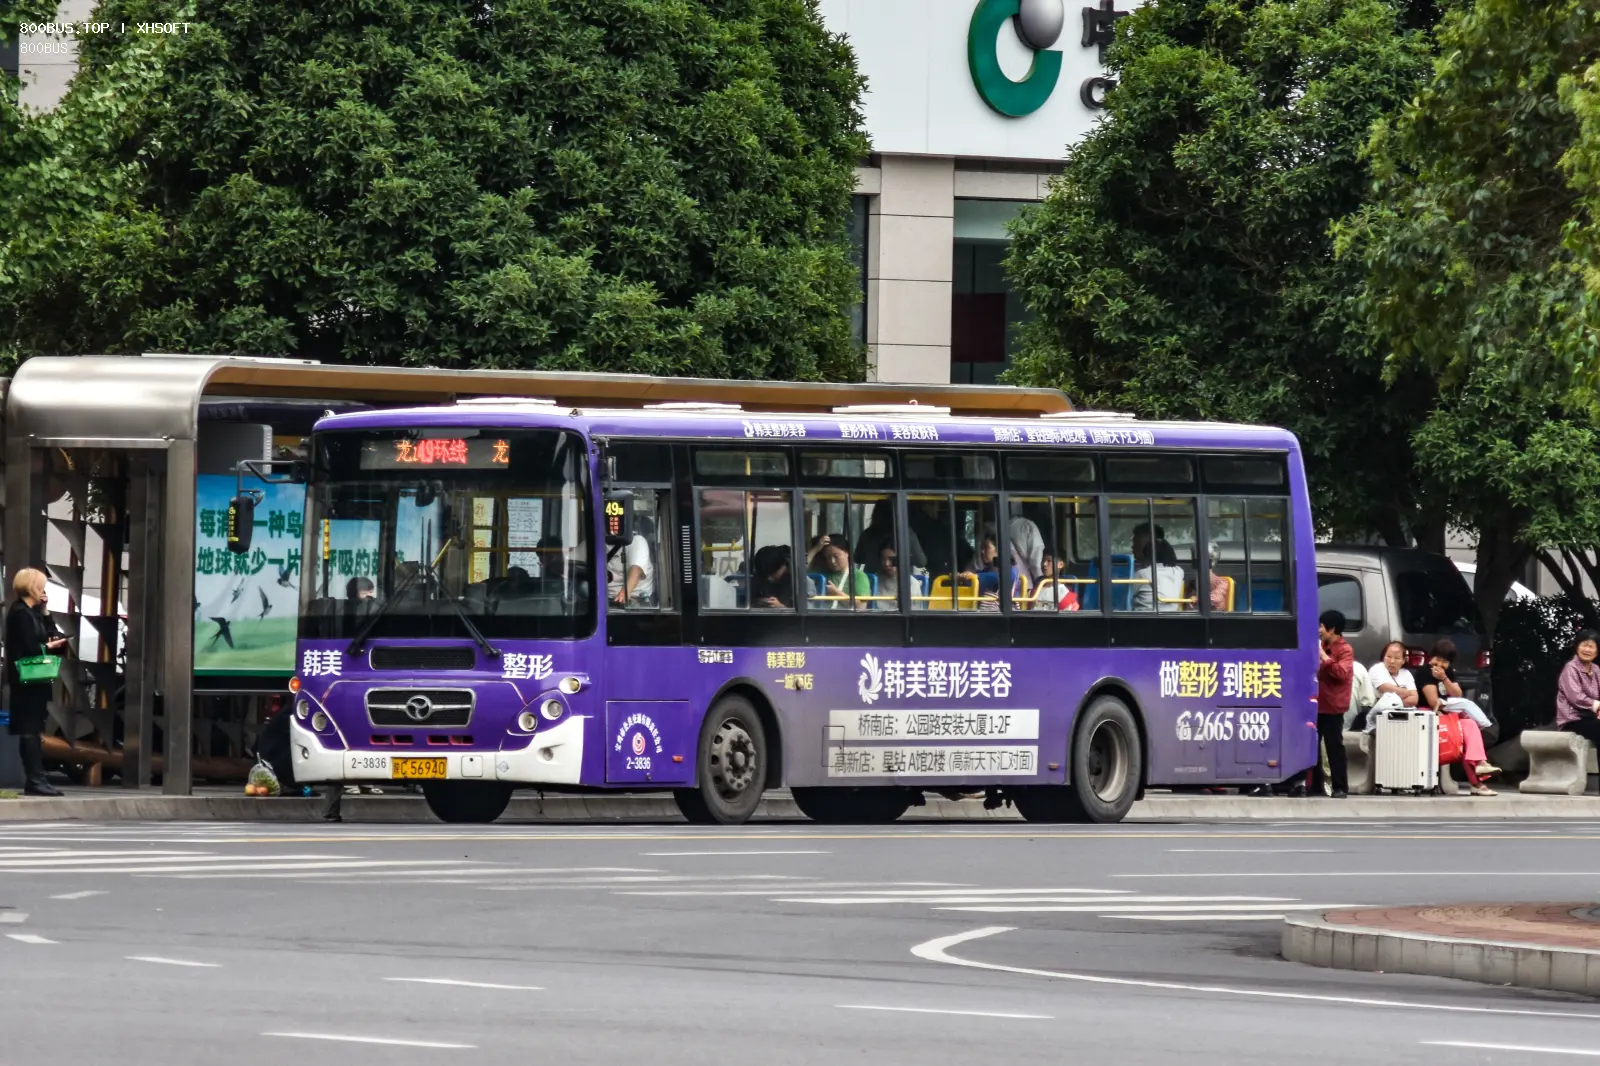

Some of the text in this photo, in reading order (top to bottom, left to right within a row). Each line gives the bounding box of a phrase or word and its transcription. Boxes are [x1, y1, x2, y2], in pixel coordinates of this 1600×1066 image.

[200, 508, 302, 538] 每消一种鸟
[302, 649, 343, 677] 韩美
[501, 652, 553, 680] 整形
[766, 651, 806, 669] 韩美整形
[883, 660, 1012, 699] 韩美整形美容
[1159, 660, 1282, 698] 做整形 到韩美
[1193, 711, 1270, 741] 2665 888
[351, 757, 387, 769] 2-3836
[626, 756, 651, 770] 2-3836
